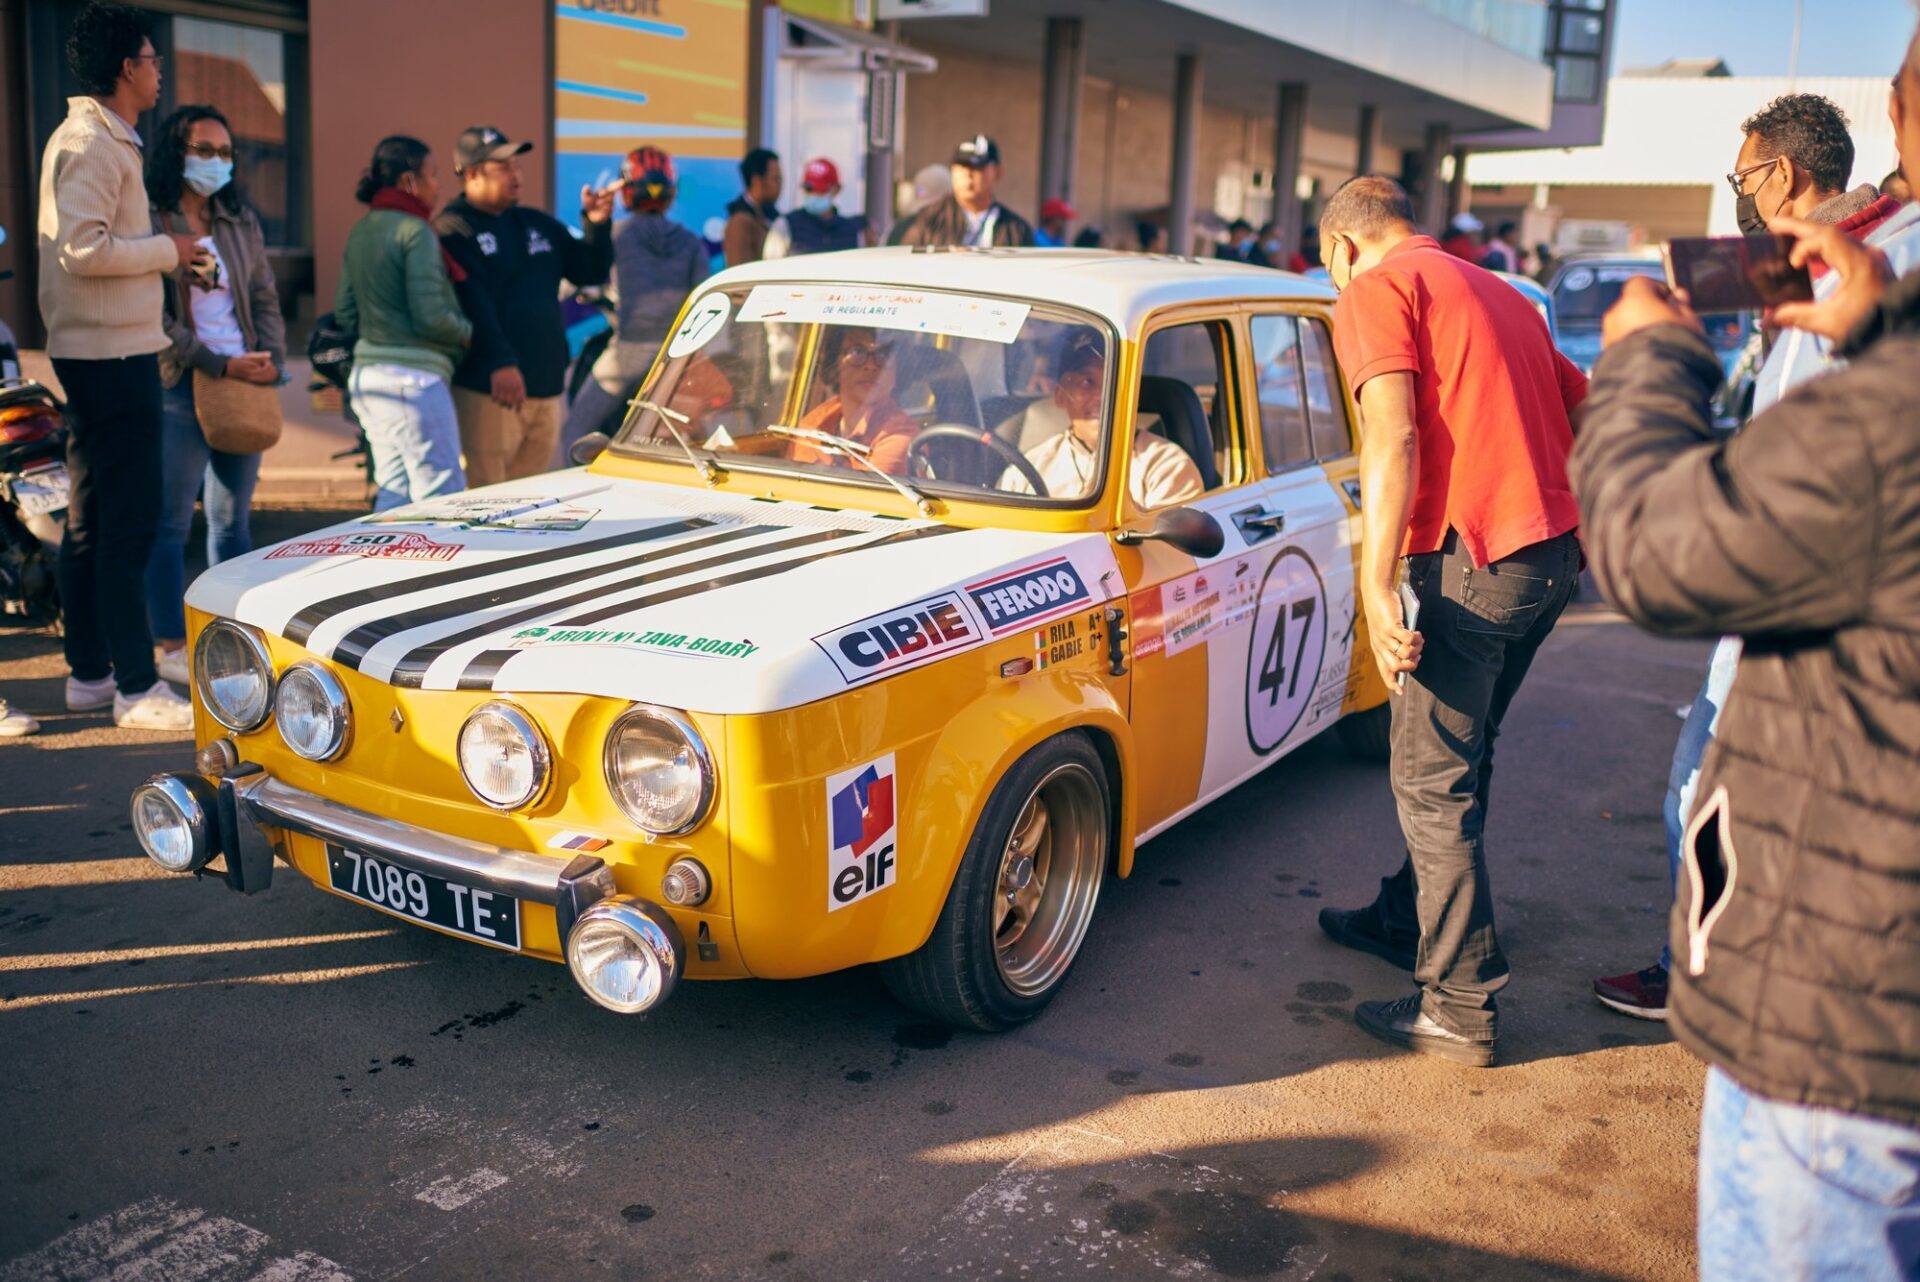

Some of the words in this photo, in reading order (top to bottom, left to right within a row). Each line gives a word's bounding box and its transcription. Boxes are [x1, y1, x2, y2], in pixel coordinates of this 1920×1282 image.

[282, 544, 340, 557] RALLYE
[350, 535, 398, 545] 50
[979, 570, 1077, 621] FERODO
[1049, 620, 1076, 645] RILA
[1089, 612, 1102, 631] A+
[634, 632, 760, 659] ZAVA-BOARY
[1050, 638, 1083, 664] GABIE
[1258, 596, 1316, 707] 47
[833, 843, 894, 903] elf
[343, 849, 430, 918] 7089
[446, 882, 496, 938] TE
